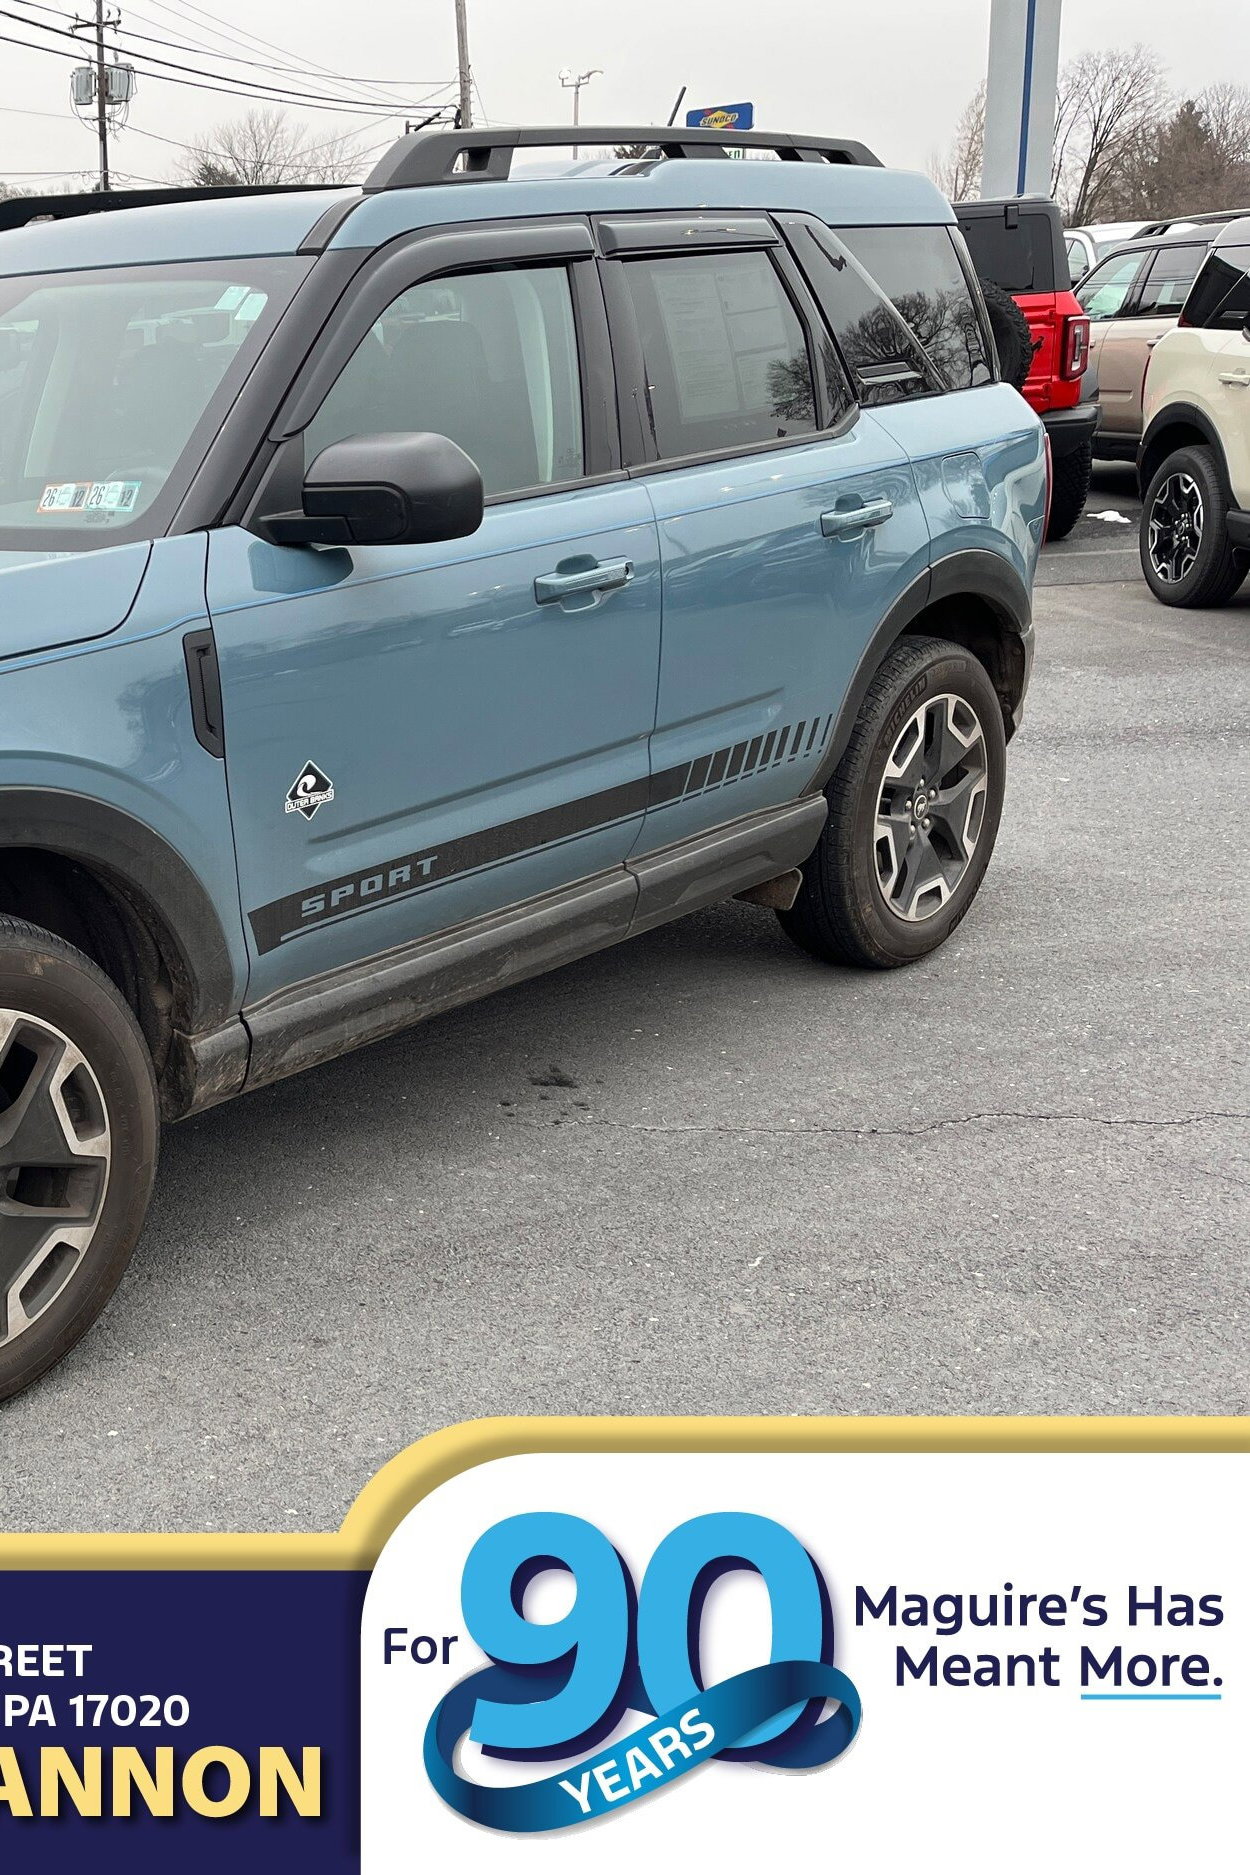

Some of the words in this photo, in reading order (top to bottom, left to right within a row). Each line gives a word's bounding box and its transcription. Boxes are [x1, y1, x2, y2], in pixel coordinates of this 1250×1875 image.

[701, 113, 737, 126] SUNOCO
[43, 487, 58, 507] 26
[72, 490, 86, 508] 12
[90, 485, 105, 506] 26
[883, 677, 926, 746] MICHELIN
[288, 798, 310, 811] OUTER
[310, 790, 333, 804] BANKS
[301, 855, 438, 918] SPORT
